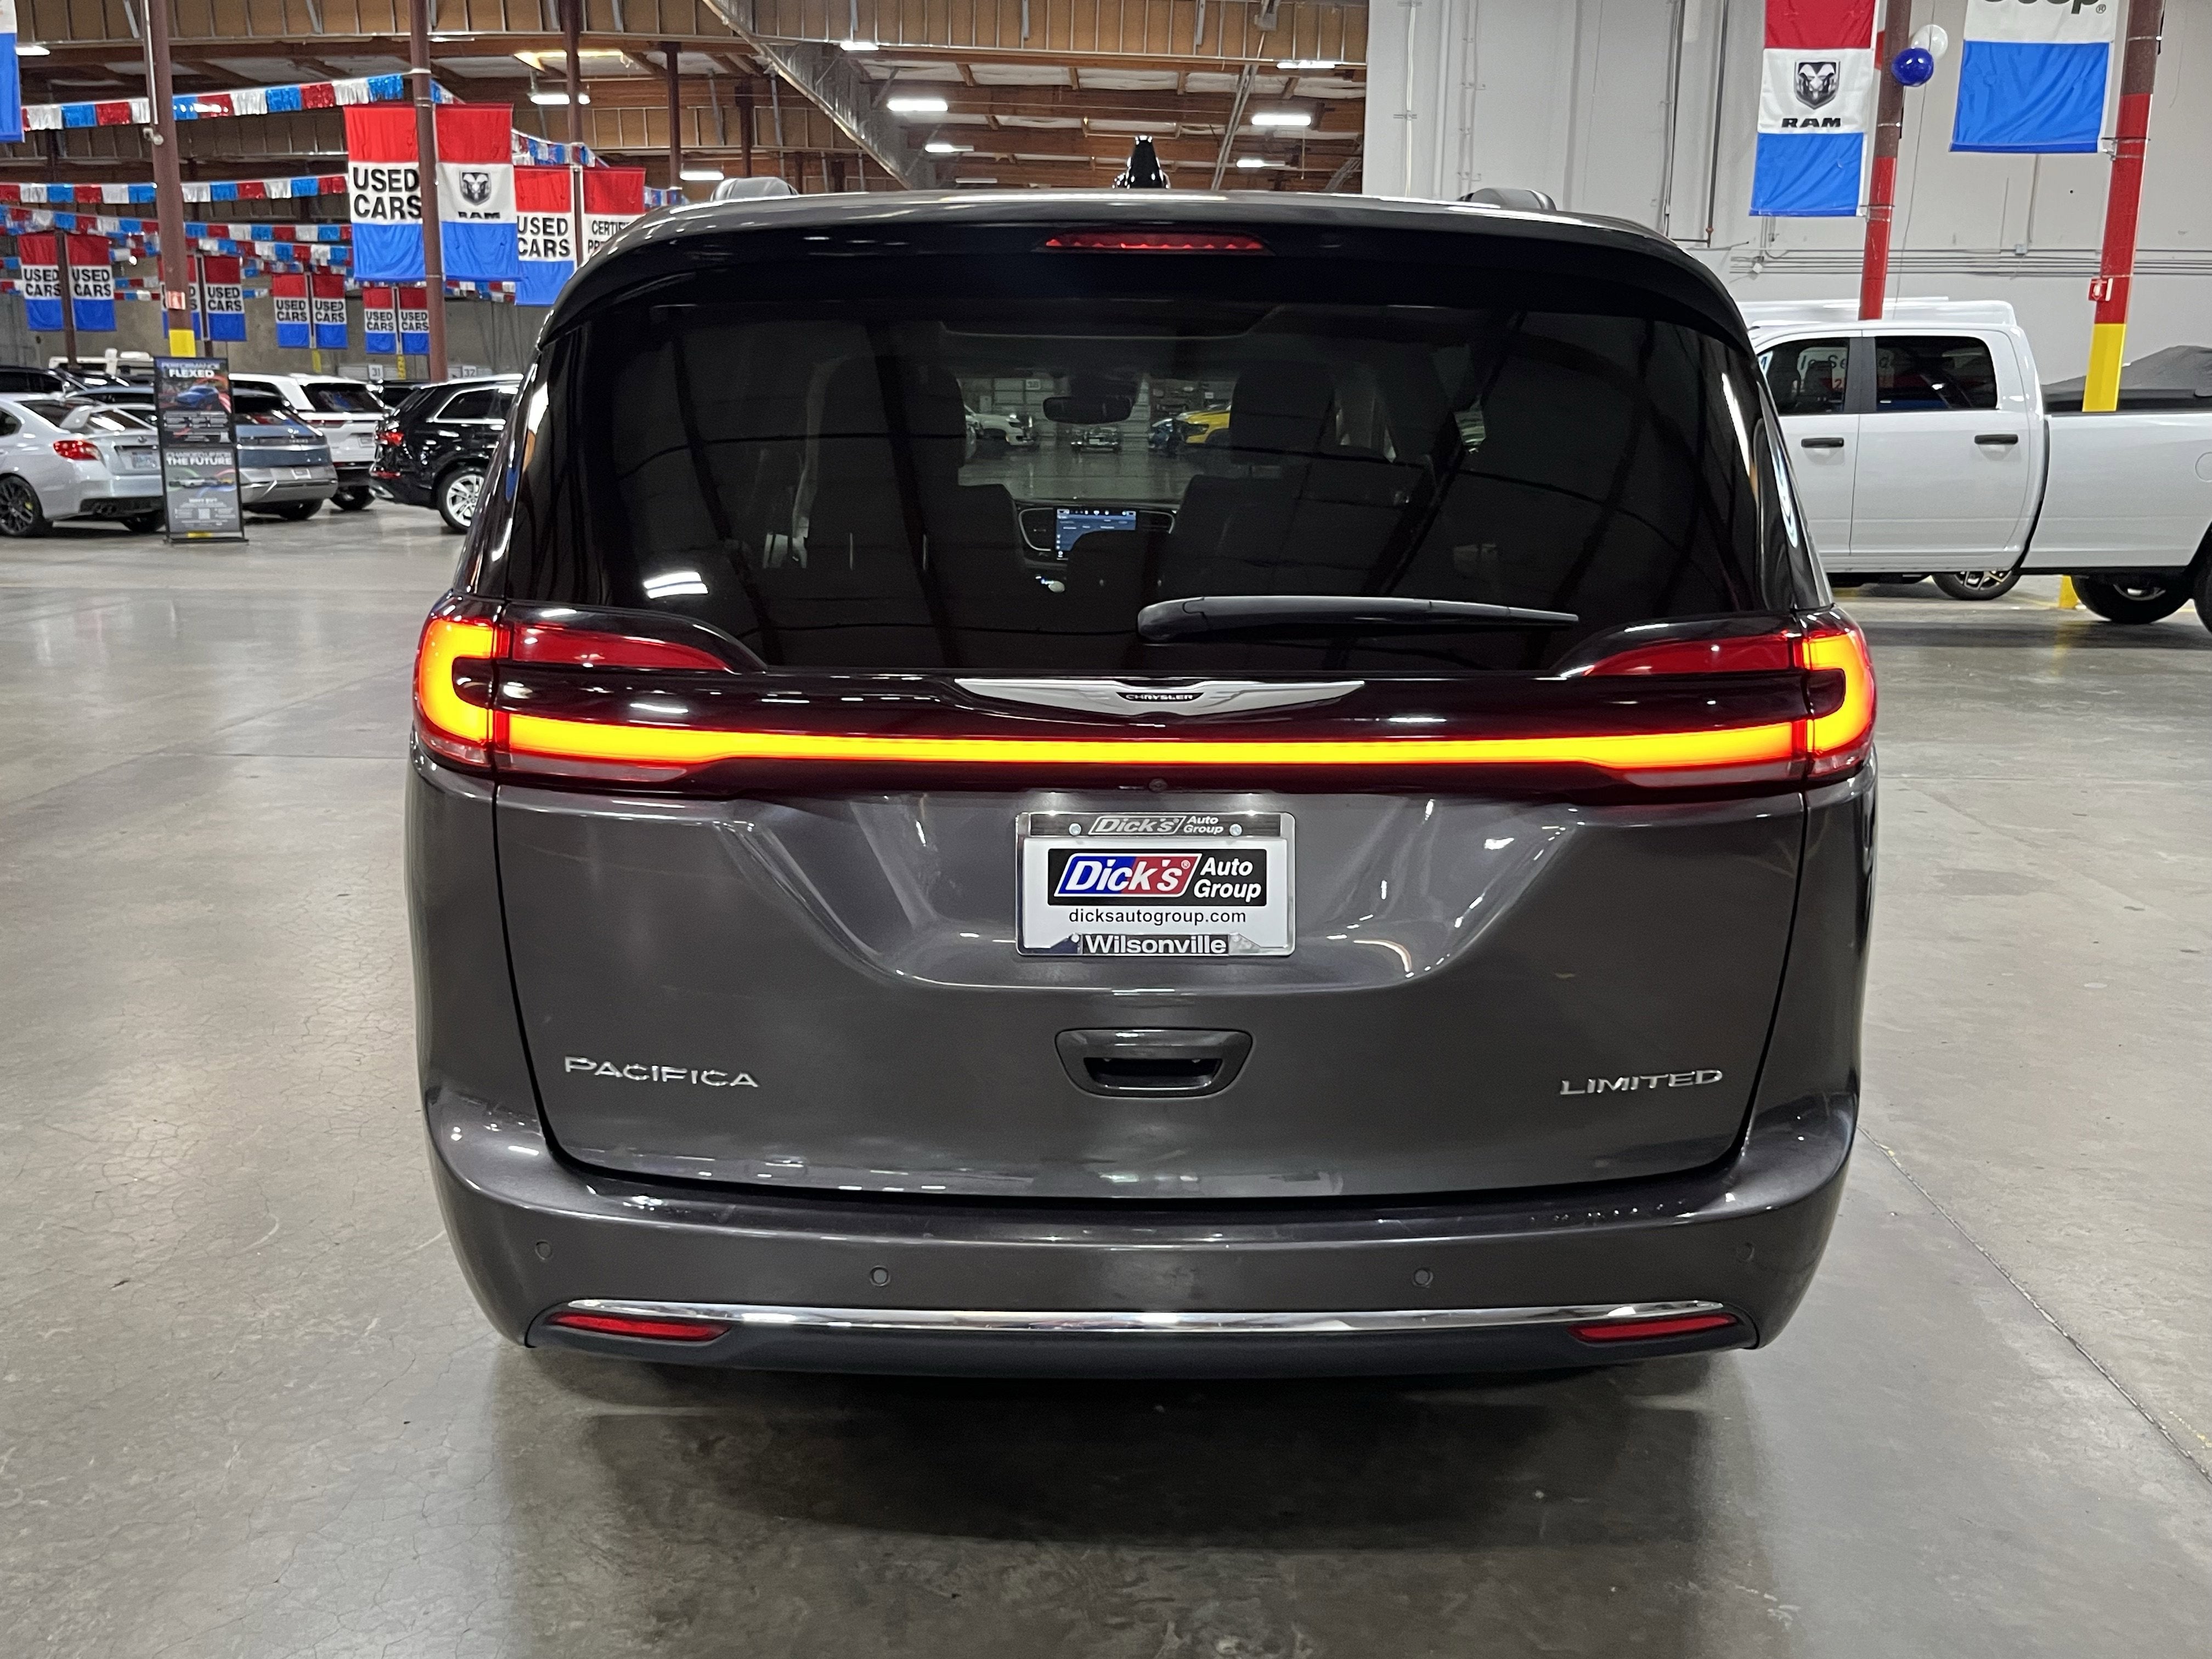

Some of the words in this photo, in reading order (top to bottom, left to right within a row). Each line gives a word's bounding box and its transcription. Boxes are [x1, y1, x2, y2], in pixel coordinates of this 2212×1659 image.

[1781, 118, 1841, 128] RAM
[353, 167, 420, 193] USED
[354, 194, 421, 219] CARS
[517, 216, 568, 236] USED
[517, 237, 571, 257] CARS
[24, 268, 59, 282] USED
[72, 269, 110, 282] USED
[25, 284, 61, 297] CARS
[74, 283, 111, 297] CARS
[207, 286, 240, 298] USED
[208, 300, 242, 311] CARS
[276, 299, 306, 310] USED
[315, 300, 343, 311] USED
[277, 312, 307, 321] CARS
[315, 312, 345, 322] CARS
[366, 311, 393, 321] USED
[401, 311, 427, 321] USED
[366, 322, 394, 331] CARS
[401, 322, 429, 331] CARS
[169, 369, 215, 378] FLEXED
[166, 456, 188, 465] THE
[190, 456, 232, 465] FUTURE
[1186, 816, 1219, 824] Auto
[1183, 825, 1223, 834] Group
[1200, 857, 1253, 877] Auto
[1193, 879, 1262, 902] Group
[1069, 908, 1246, 926] dicksautogroup.com
[1085, 934, 1227, 954] Wilsonville
[565, 1056, 759, 1088] PACIFICA
[1560, 1070, 1723, 1095] LIMITED
